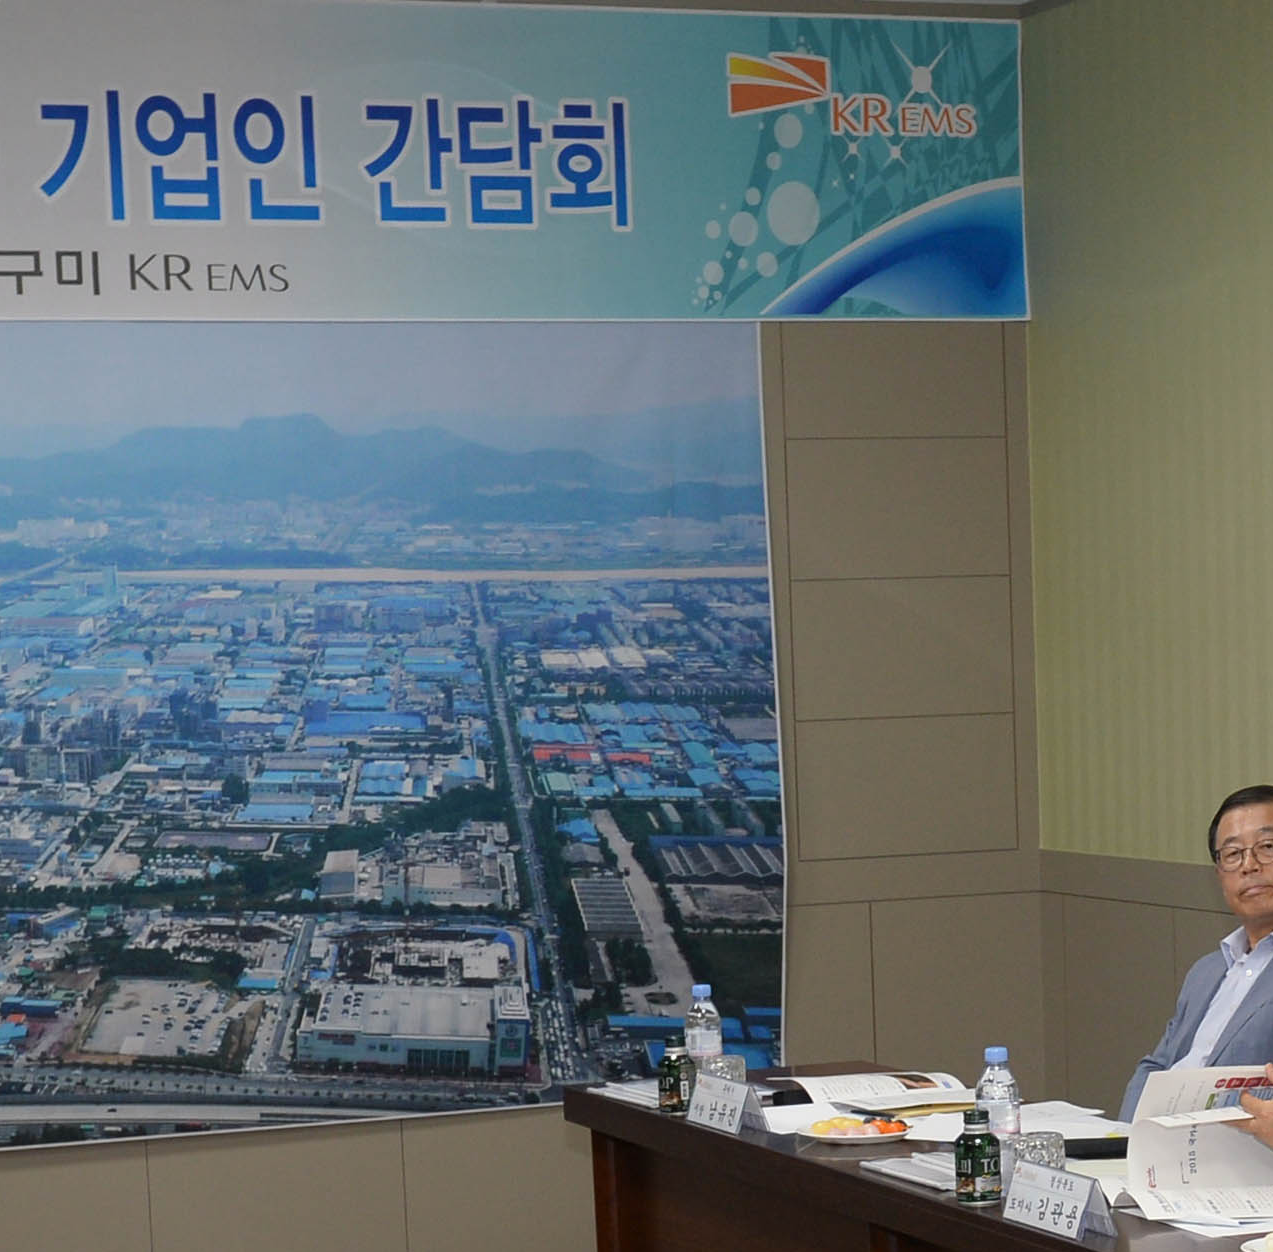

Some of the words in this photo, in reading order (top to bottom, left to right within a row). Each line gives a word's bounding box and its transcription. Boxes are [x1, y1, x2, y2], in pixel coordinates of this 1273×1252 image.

[831, 94, 889, 134] KR
[900, 104, 977, 136] EMS
[39, 89, 323, 222] 기업인
[362, 96, 631, 229] 간담회
[130, 253, 194, 292] KR
[208, 263, 290, 293] EMS
[1037, 1196, 1078, 1230] 김관용
